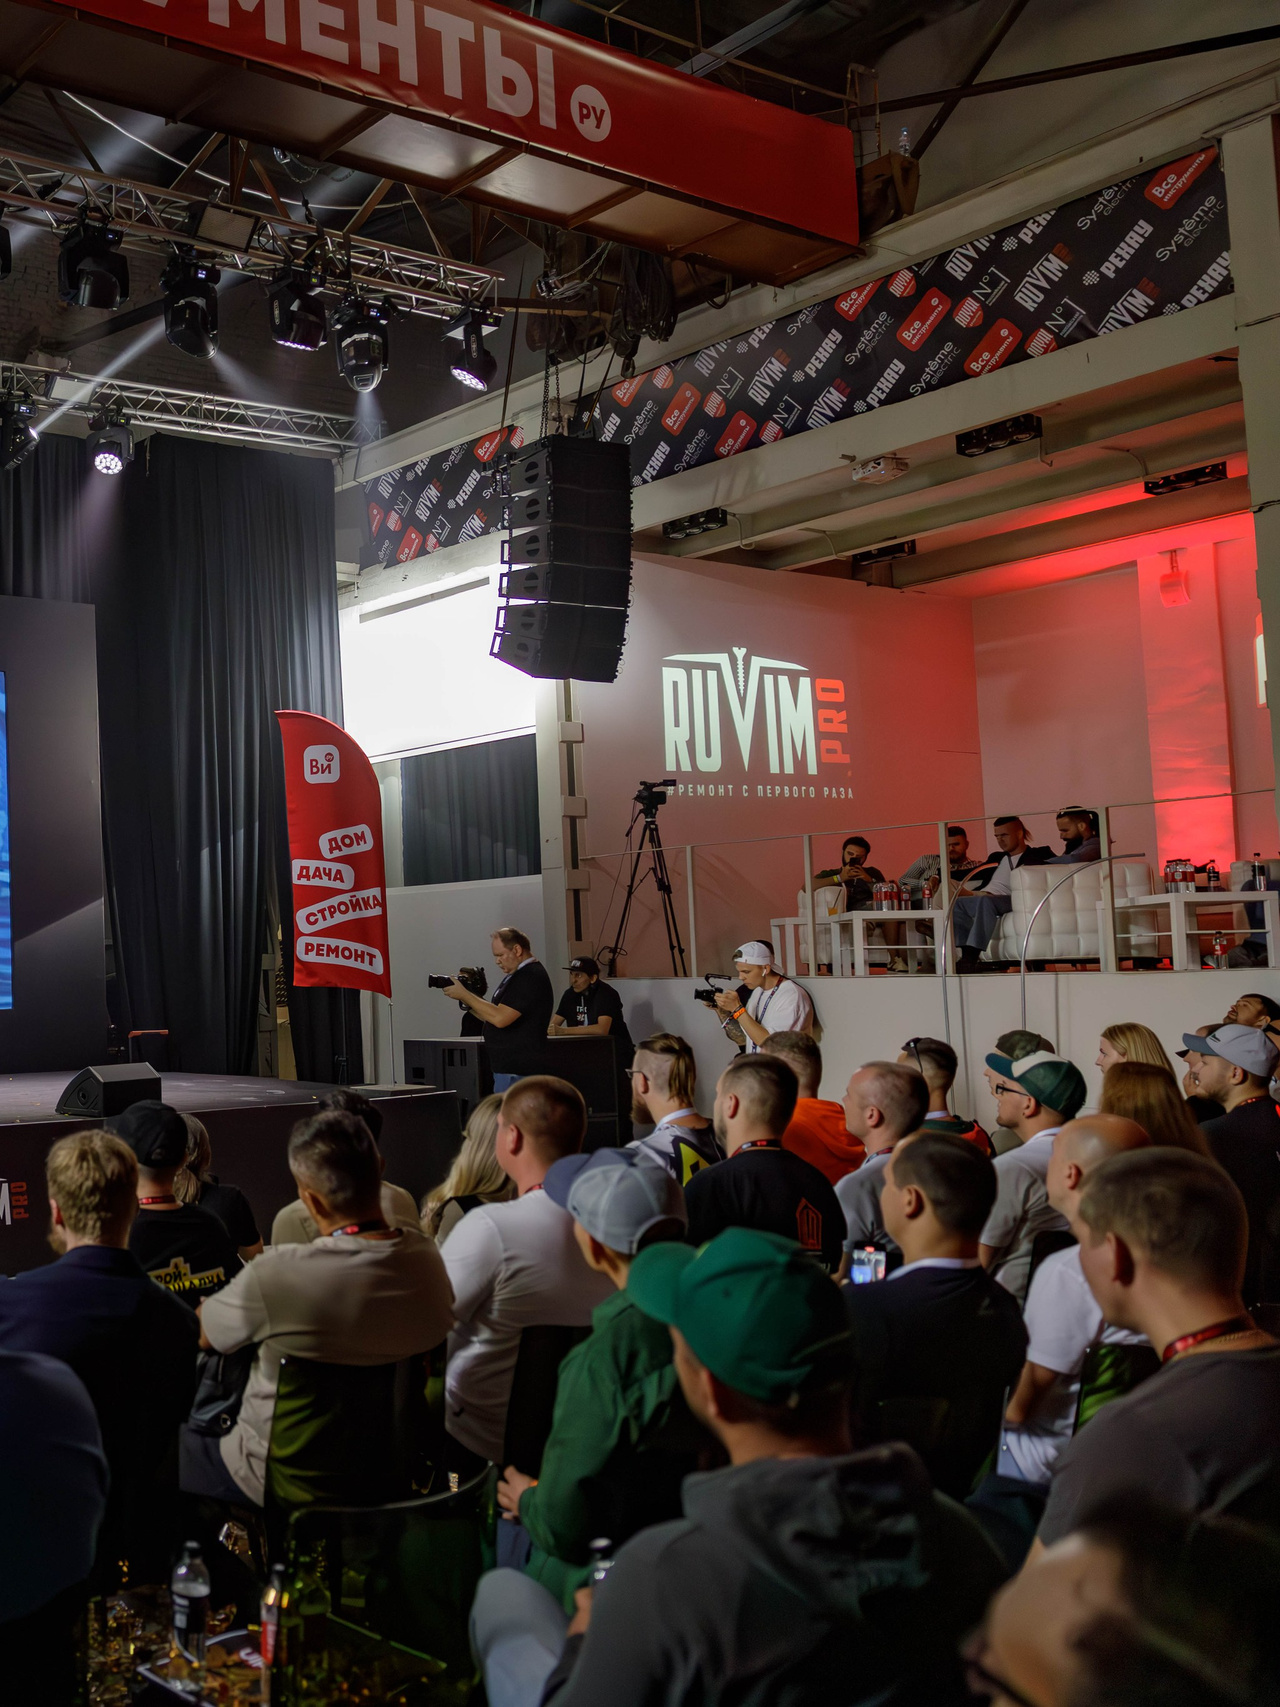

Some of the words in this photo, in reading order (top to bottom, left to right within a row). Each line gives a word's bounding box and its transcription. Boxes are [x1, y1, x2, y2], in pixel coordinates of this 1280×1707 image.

[1151, 173, 1177, 198] Все
[1155, 195, 1216, 262] Système
[1183, 200, 1225, 248] electric
[1013, 252, 1069, 312] RUVIM
[840, 291, 858, 311] Все
[844, 311, 888, 365] Système
[902, 320, 922, 341] Все
[970, 351, 991, 372] Все
[616, 381, 630, 398] Все
[747, 356, 787, 406] RUVIM
[624, 400, 654, 445] Système
[665, 409, 680, 426] Все
[478, 441, 490, 456] Все
[719, 438, 734, 456] Все
[414, 483, 441, 522] RUVIM
[400, 547, 410, 561] Все
[662, 653, 817, 775] RUVIM
[815, 678, 851, 763] PRO
[742, 785, 749, 798] С
[757, 785, 815, 798] ПЕРВОГО
[823, 787, 854, 799] РАЗА
[328, 830, 367, 854] ДОМ
[297, 865, 345, 884] ДАЧА
[305, 894, 382, 926] СТРОЙКА
[304, 942, 377, 967] РЕМОНТ
[10, 1182, 29, 1219] PRO
